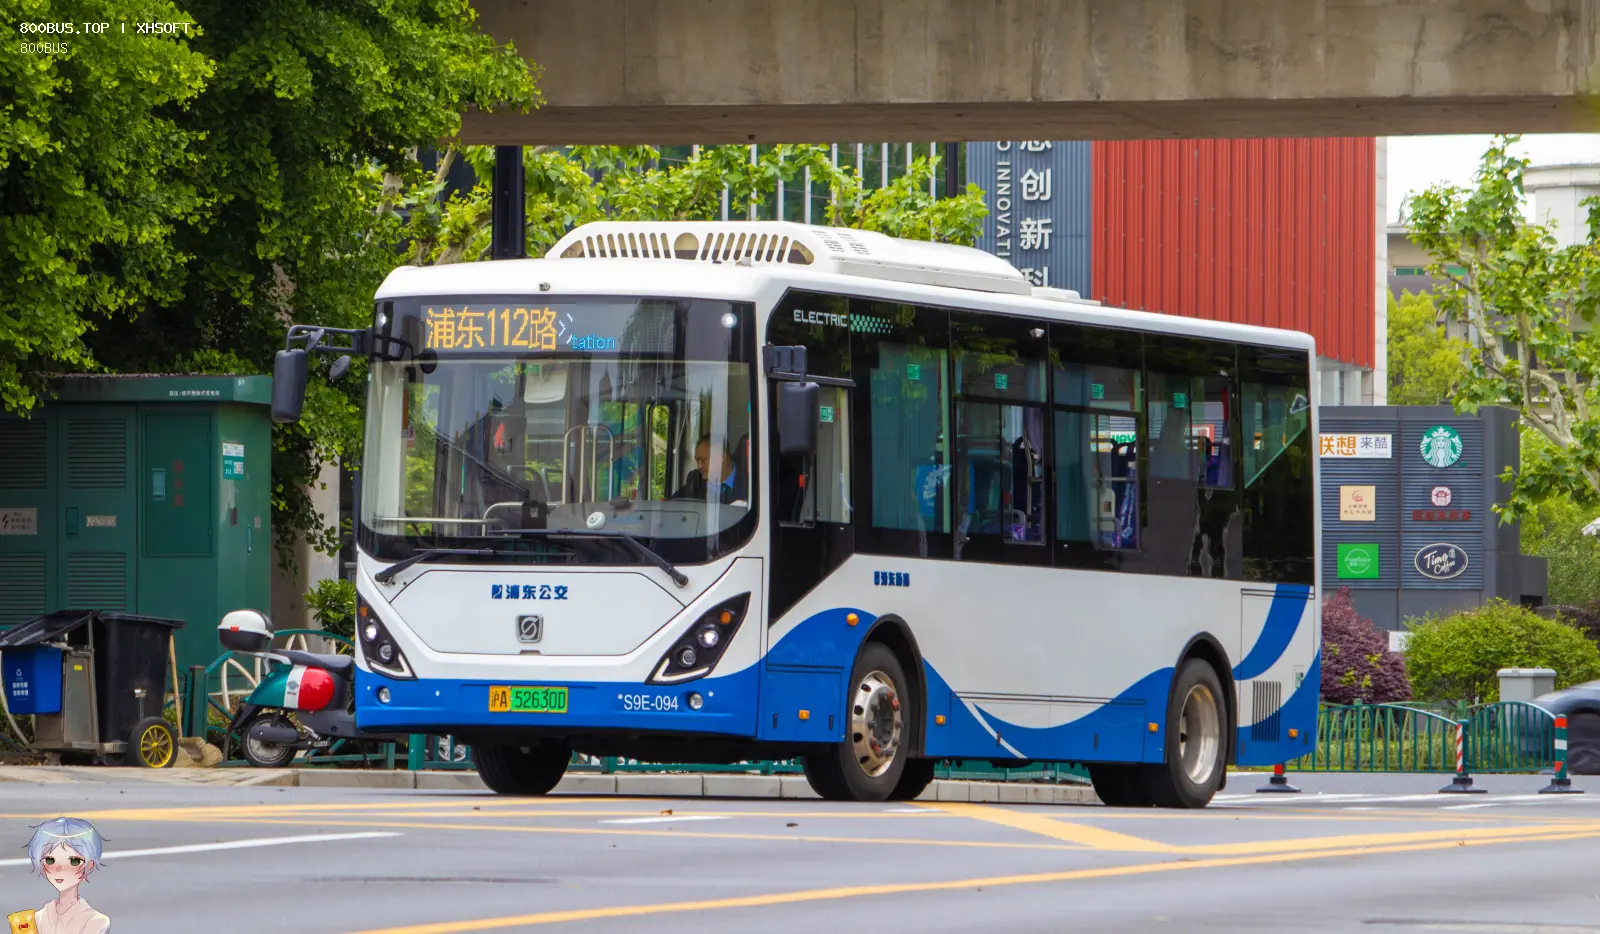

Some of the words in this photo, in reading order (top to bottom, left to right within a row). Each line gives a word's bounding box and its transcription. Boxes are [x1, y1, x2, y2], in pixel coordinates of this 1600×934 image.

[996, 161, 1011, 264] INNOVATI
[793, 309, 848, 328] ELECTRIC
[426, 307, 557, 350] 浦东112路
[572, 334, 616, 350] tation
[1360, 436, 1389, 449] 来酷
[505, 584, 568, 600] 浦东公交
[623, 694, 679, 711] S9E-094
